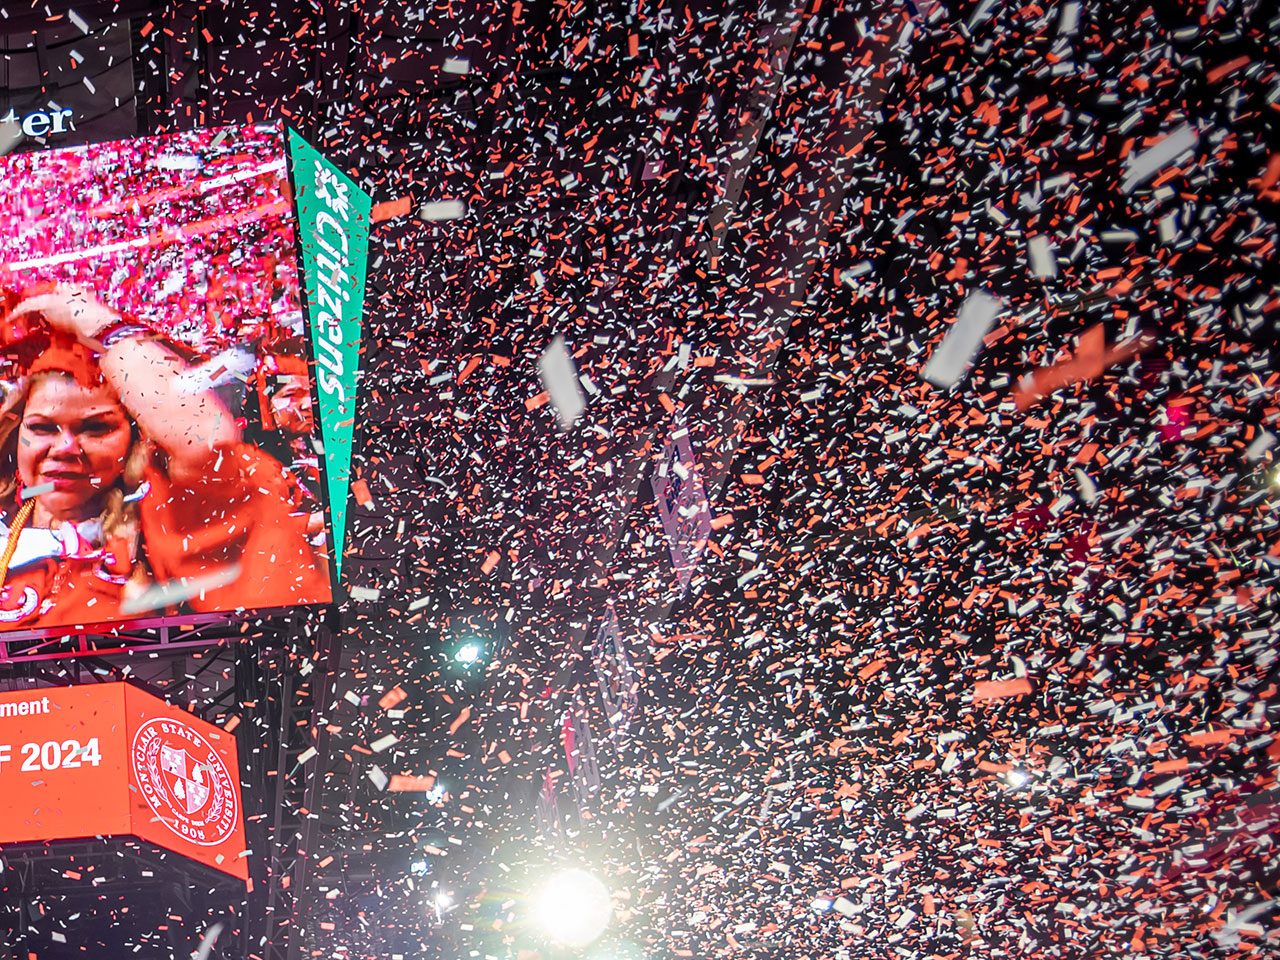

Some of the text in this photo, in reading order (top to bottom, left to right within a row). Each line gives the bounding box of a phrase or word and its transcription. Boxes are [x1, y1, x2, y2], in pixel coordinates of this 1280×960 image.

[315, 210, 350, 403] Citizens
[20, 737, 102, 773] 2024
[136, 726, 163, 809] MONTCLAIR
[161, 723, 202, 747] STATE
[207, 752, 234, 836] UNIVERSITY
